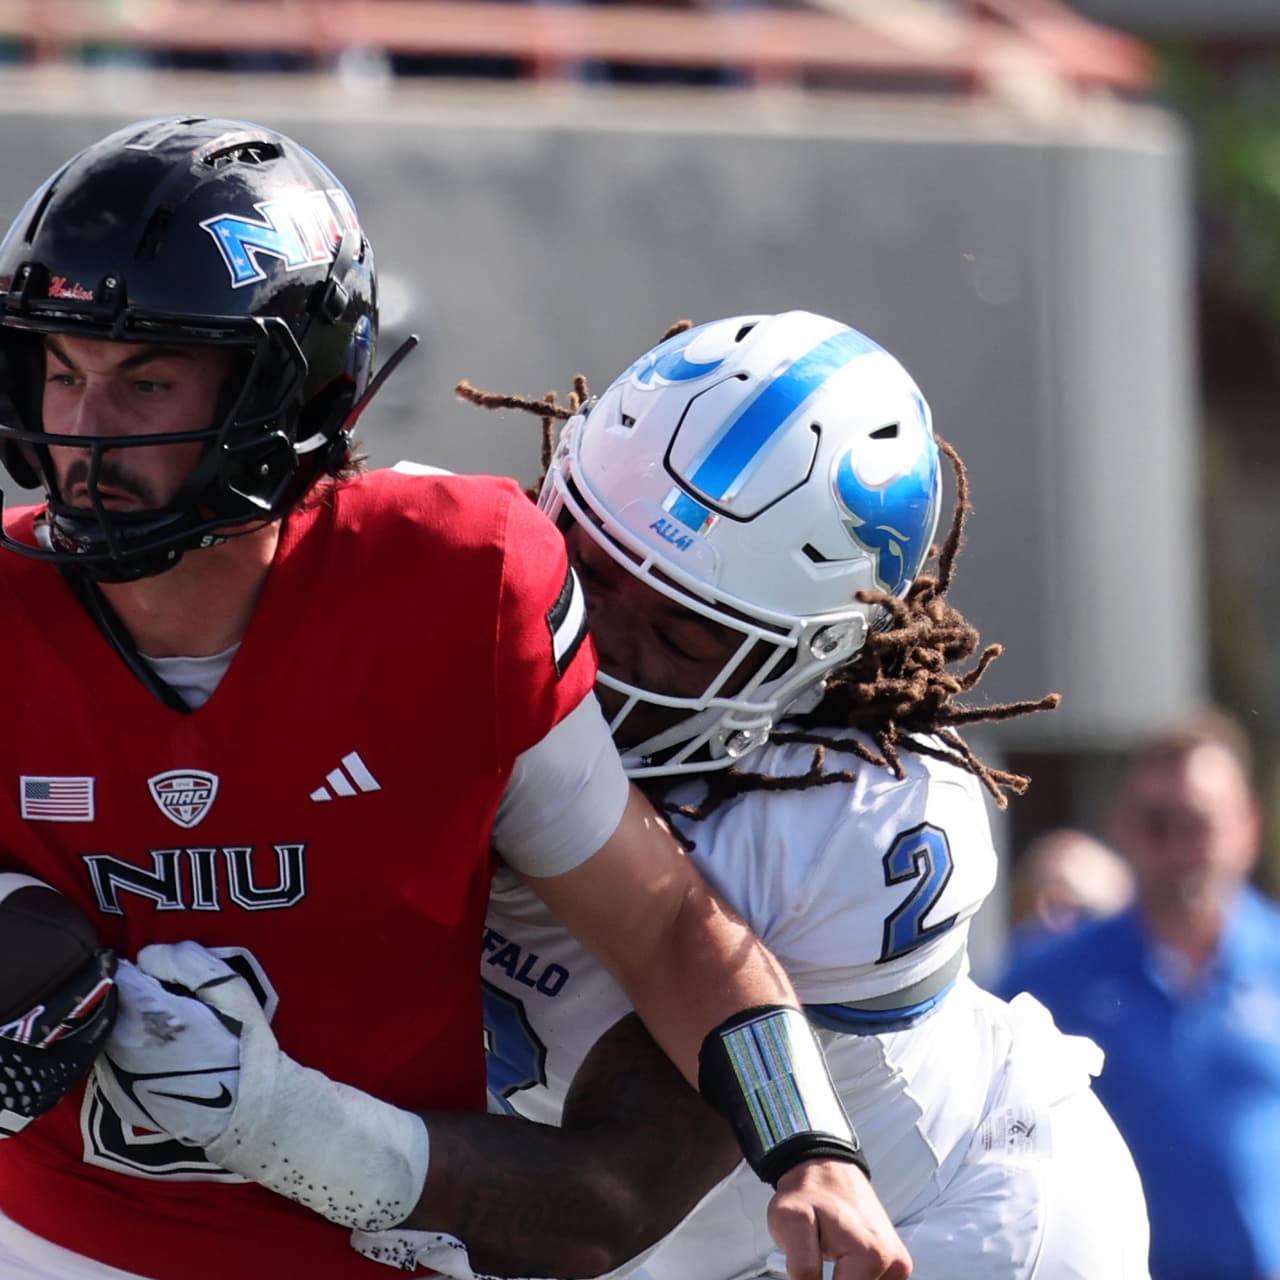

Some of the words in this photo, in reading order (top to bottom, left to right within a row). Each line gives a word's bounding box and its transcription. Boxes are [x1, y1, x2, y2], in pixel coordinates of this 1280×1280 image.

[160, 790, 210, 805] MAC
[82, 844, 305, 916] NIU
[874, 821, 960, 966] 2
[482, 926, 570, 998] FALO
